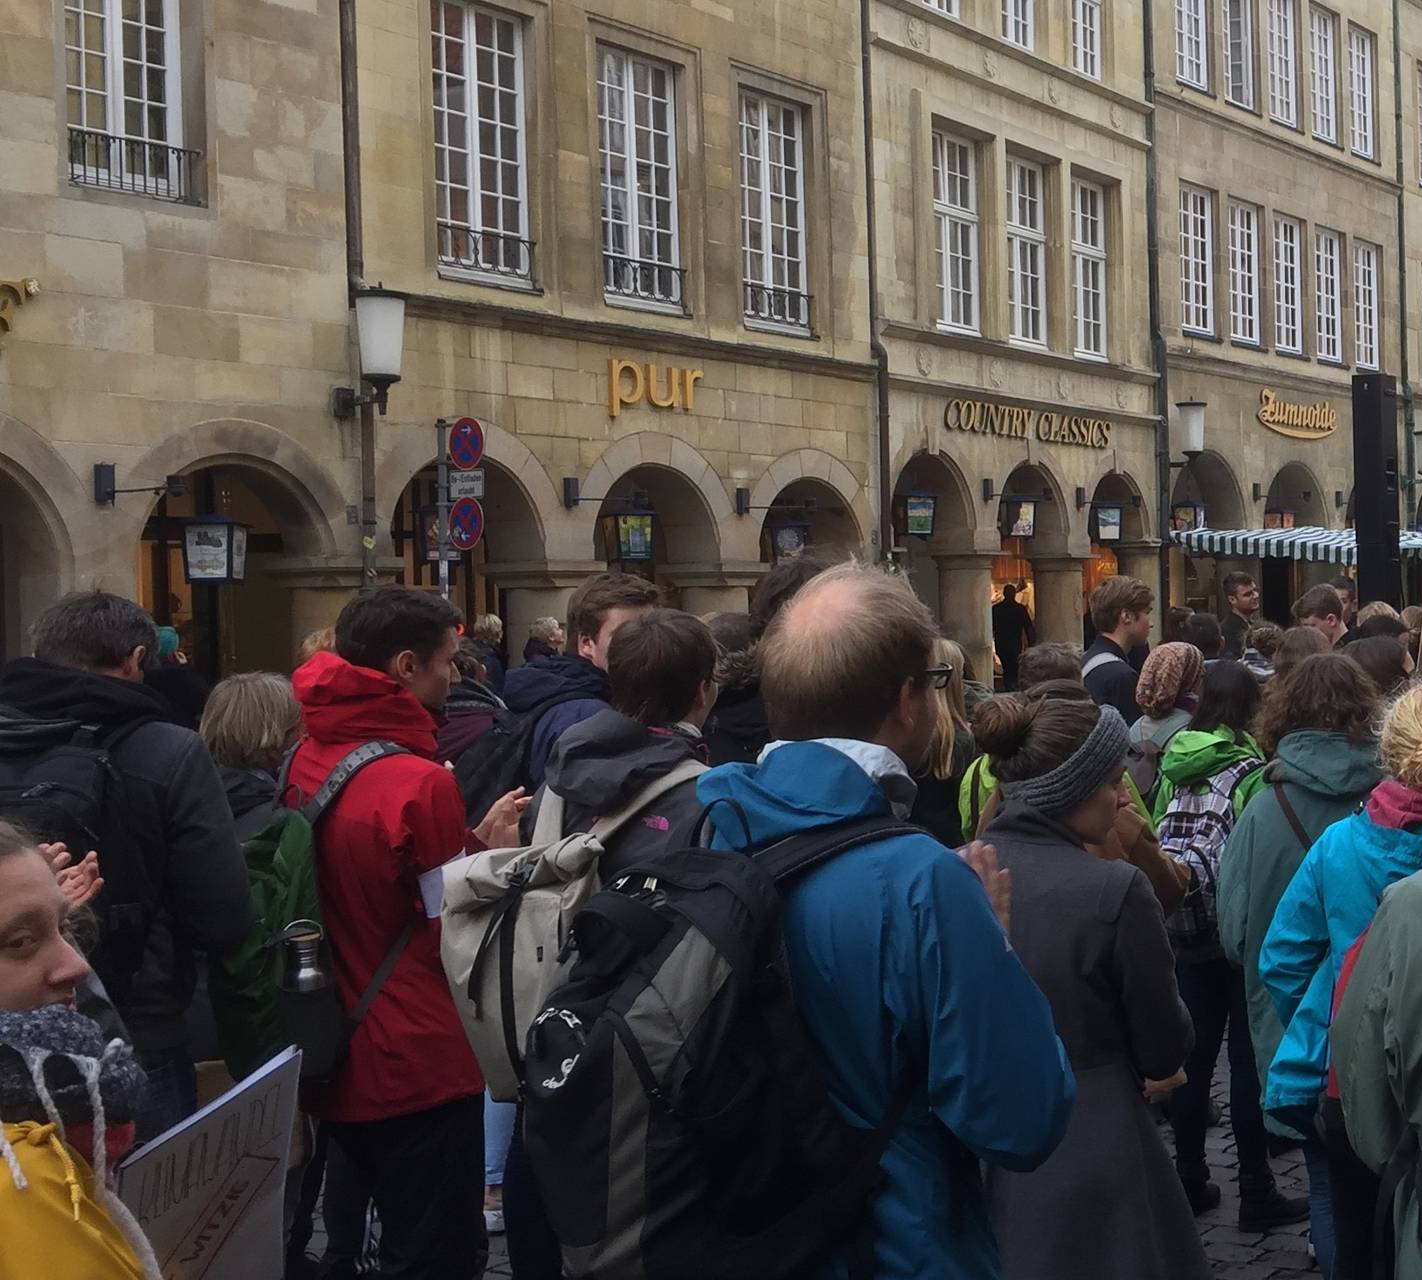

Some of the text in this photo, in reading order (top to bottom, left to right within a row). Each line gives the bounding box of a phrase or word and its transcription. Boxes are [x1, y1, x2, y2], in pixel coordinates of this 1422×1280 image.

[608, 359, 704, 417] pur
[944, 400, 1112, 449] COUNTRY CLASSICS
